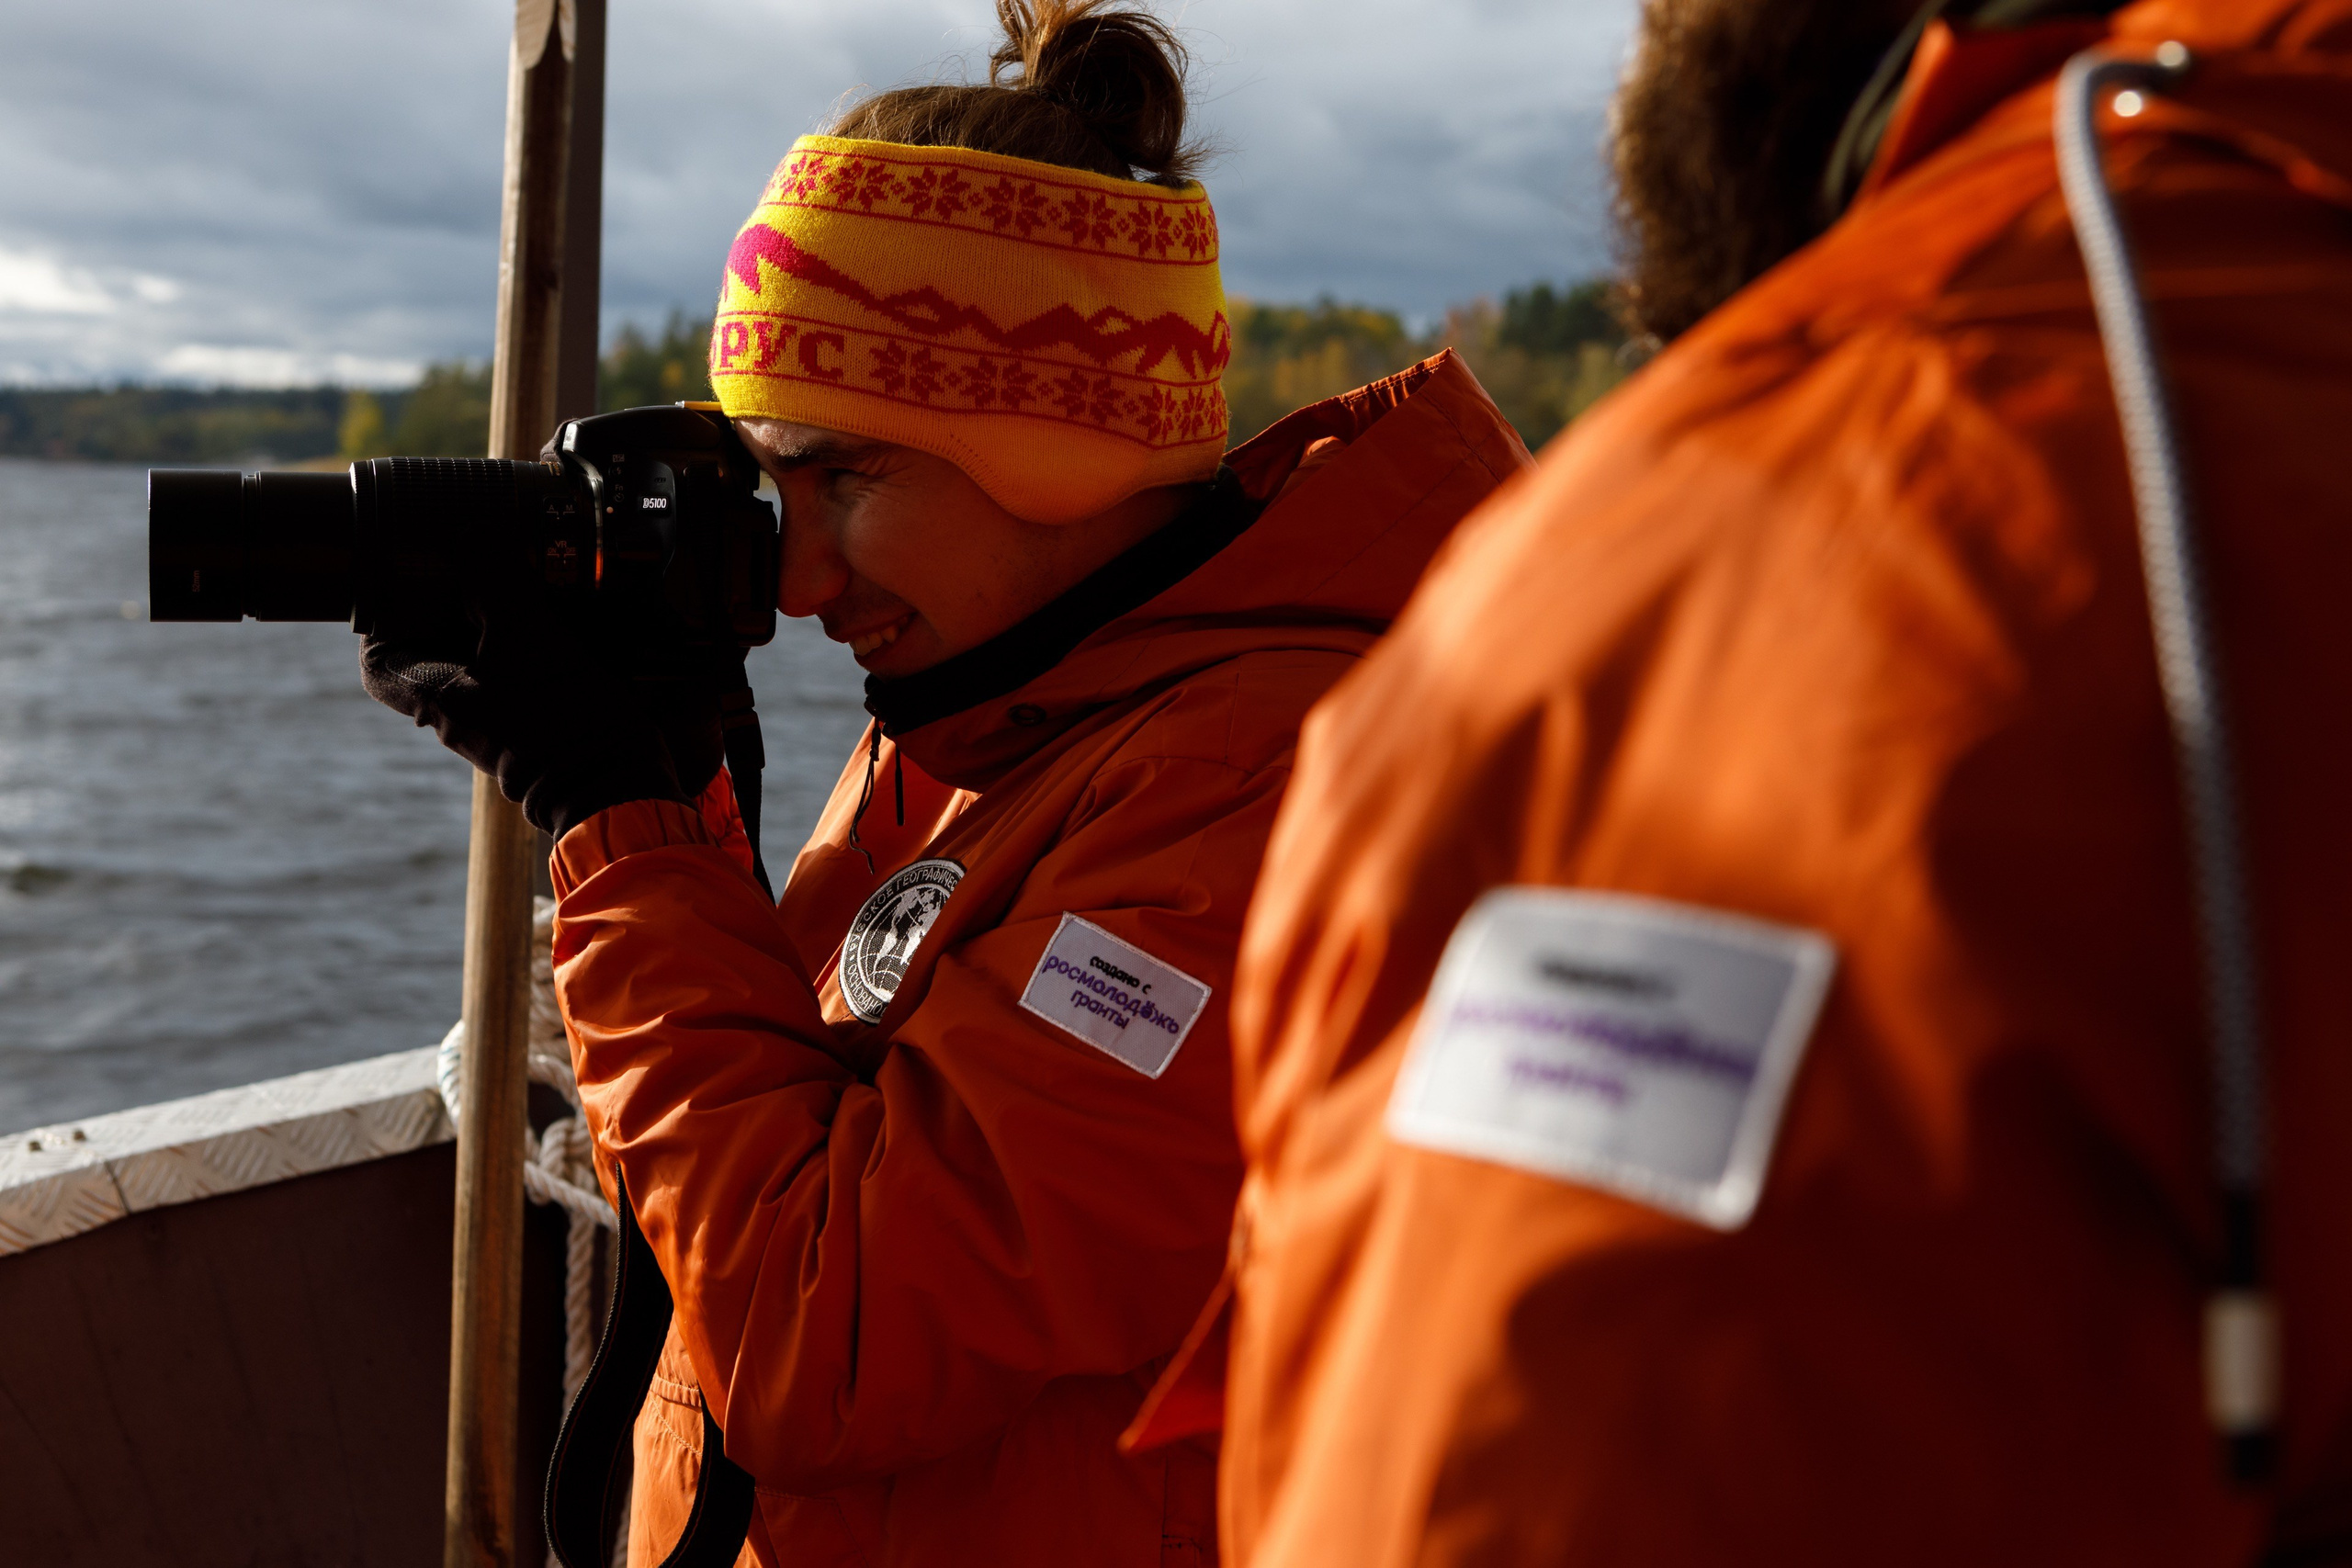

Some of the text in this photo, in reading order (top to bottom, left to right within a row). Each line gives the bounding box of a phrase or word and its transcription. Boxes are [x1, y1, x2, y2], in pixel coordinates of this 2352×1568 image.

[710, 321, 844, 381] РУС
[642, 497, 668, 509] D5100
[847, 964, 883, 1015] ОСНОВАНО
[1042, 955, 1180, 1034] росмолодёжь
[1089, 955, 1152, 995] создано с
[1070, 989, 1130, 1030] гранты
